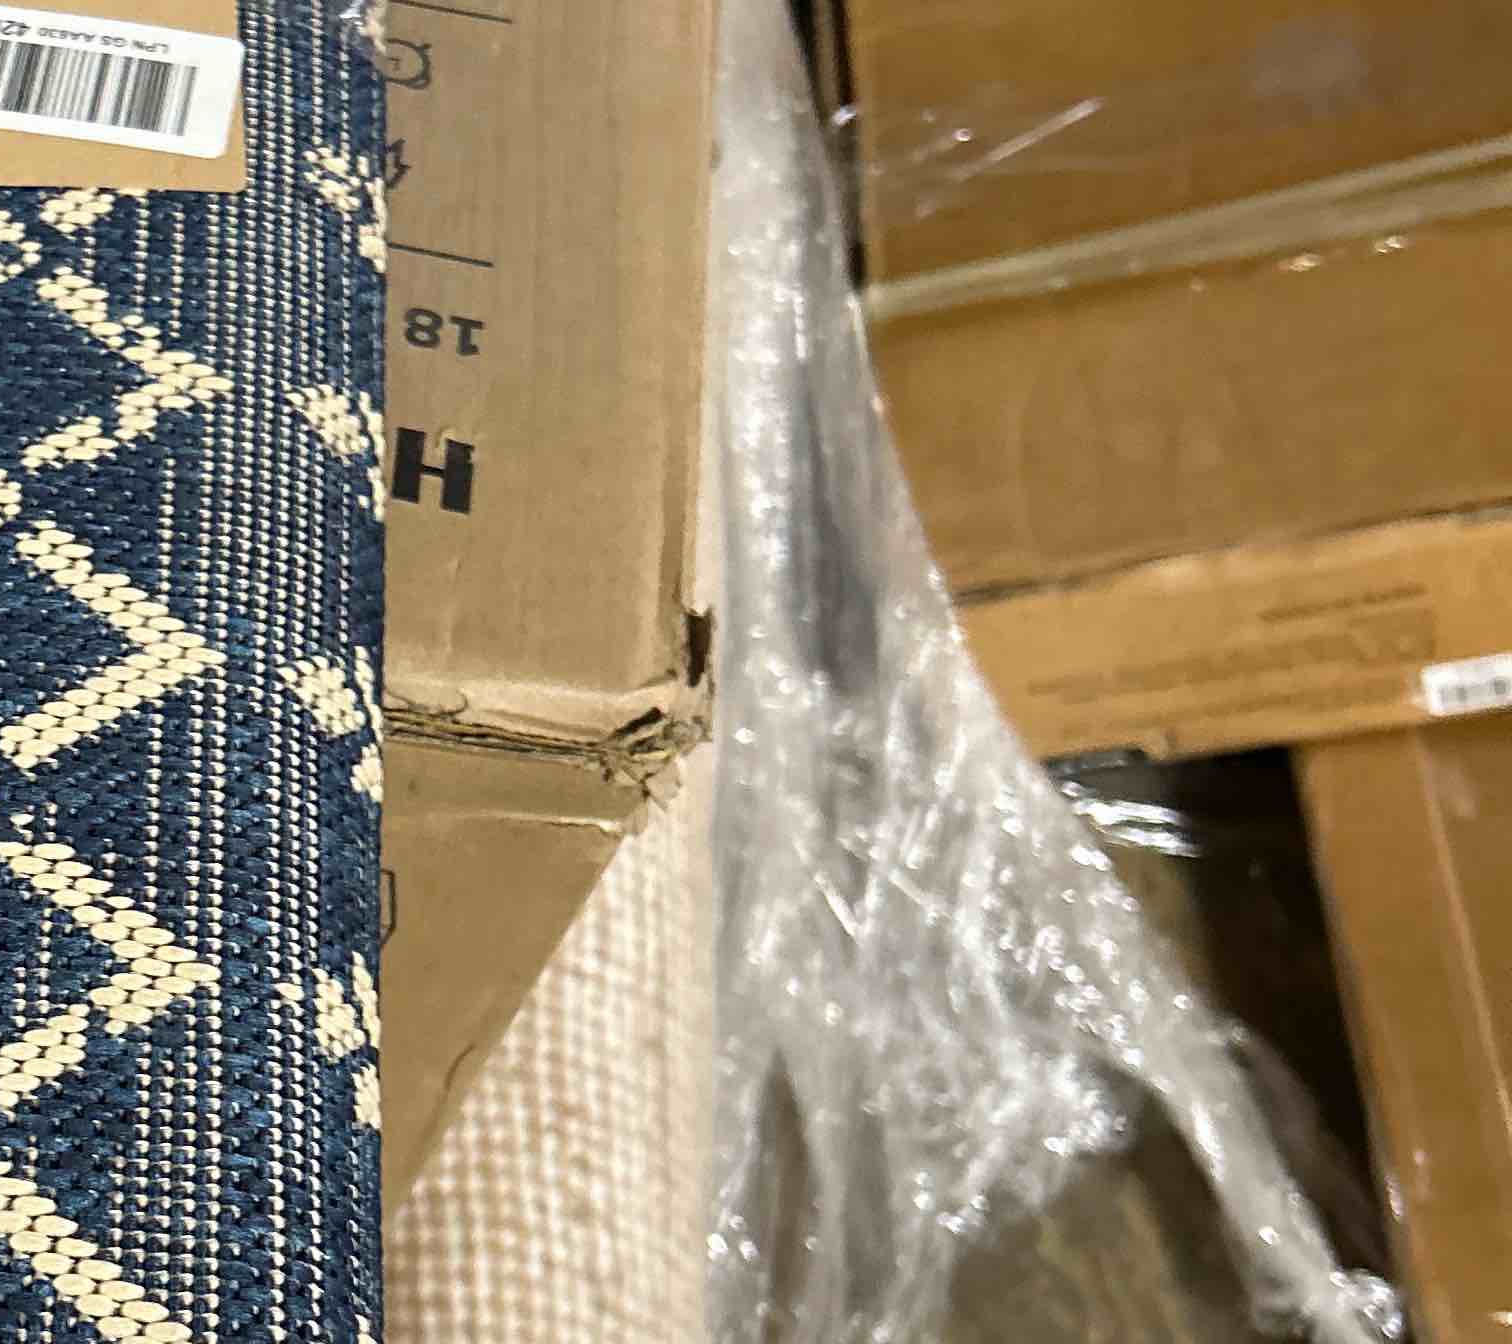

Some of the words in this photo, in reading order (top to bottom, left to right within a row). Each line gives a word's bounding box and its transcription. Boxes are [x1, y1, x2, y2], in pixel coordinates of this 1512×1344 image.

[131, 39, 170, 53] LPN
[405, 309, 485, 355] 18
[392, 427, 474, 514] H
